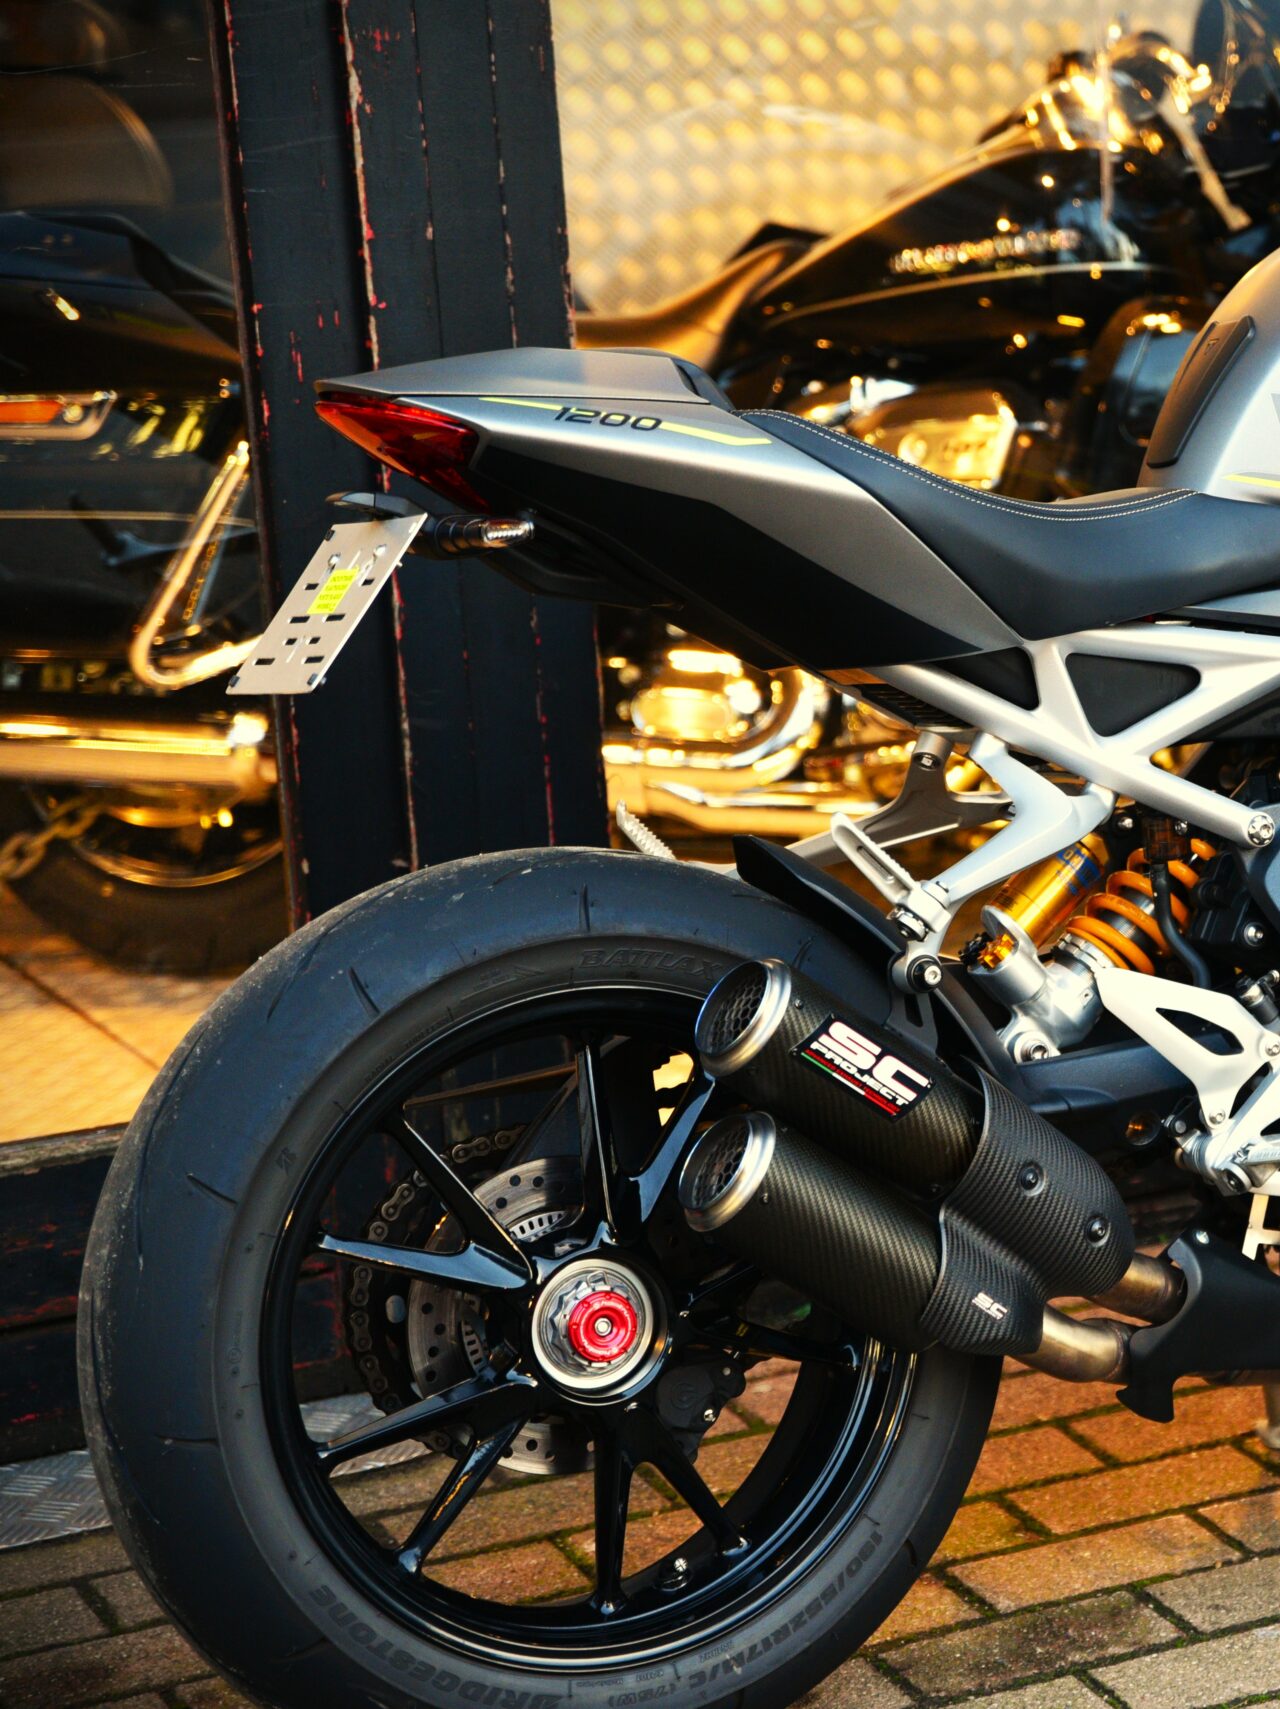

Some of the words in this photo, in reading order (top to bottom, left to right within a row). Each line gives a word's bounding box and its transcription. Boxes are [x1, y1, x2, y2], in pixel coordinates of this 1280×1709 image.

[554, 406, 662, 431] 1200
[578, 947, 724, 982] BATTLAX
[809, 1040, 909, 1106] PROJECT
[817, 1020, 930, 1102] SC
